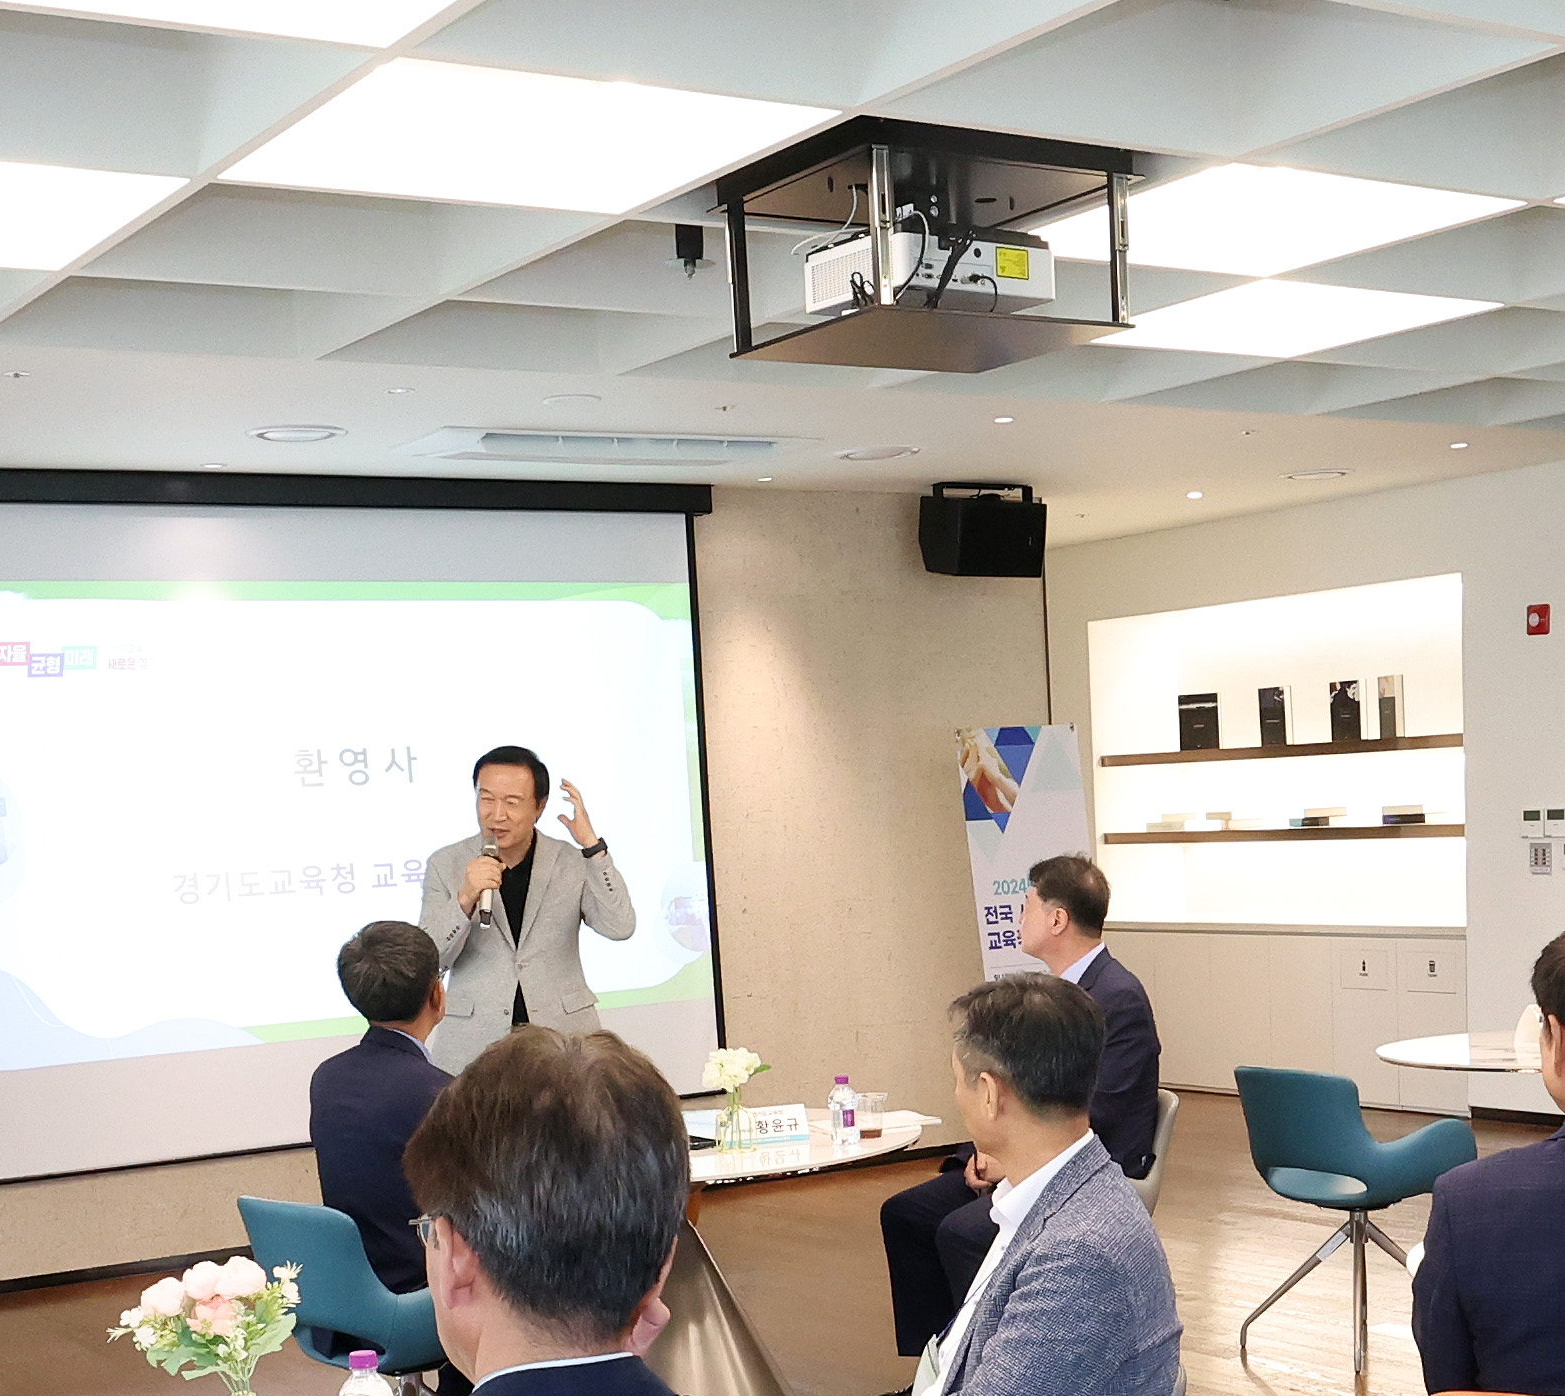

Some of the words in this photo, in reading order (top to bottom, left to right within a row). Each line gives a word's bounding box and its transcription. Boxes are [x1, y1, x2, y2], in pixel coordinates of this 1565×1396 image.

[31, 655, 61, 675] 균형
[172, 862, 357, 905] 경기도교육청
[371, 858, 428, 889] 교육
[984, 904, 1013, 925] 전국
[755, 1117, 800, 1135] 황윤규
